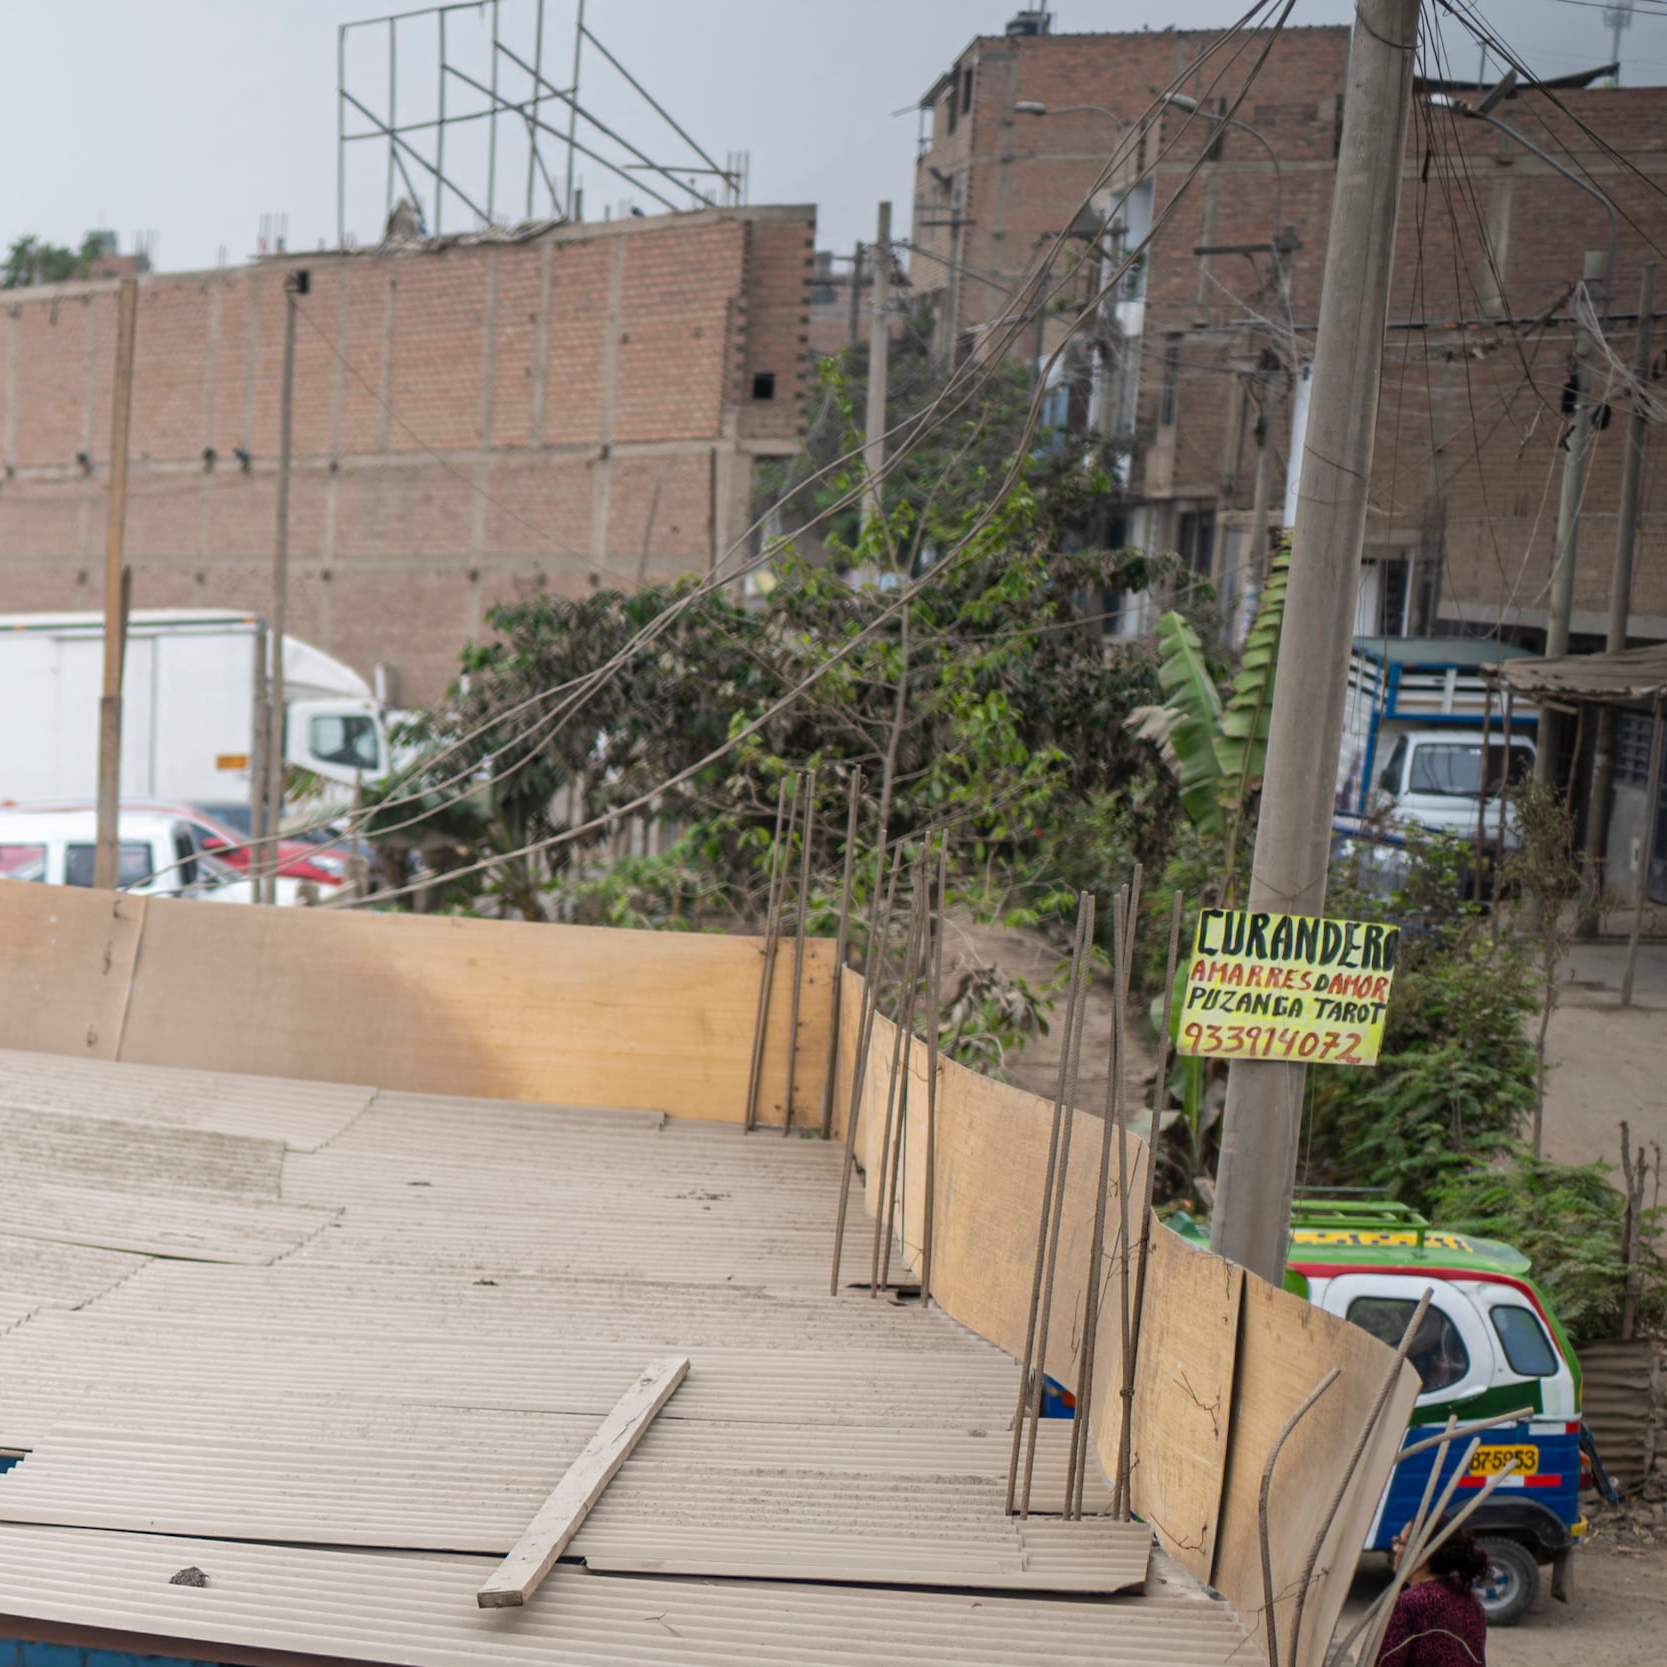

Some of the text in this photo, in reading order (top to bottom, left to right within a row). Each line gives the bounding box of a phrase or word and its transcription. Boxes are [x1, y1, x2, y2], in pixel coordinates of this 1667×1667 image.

[1190, 960, 1312, 990] AMARRES
[1328, 974, 1389, 1002] AMOR
[1187, 987, 1386, 1024] PUZANGA TAROT
[1185, 1023, 1362, 1063] 933914072
